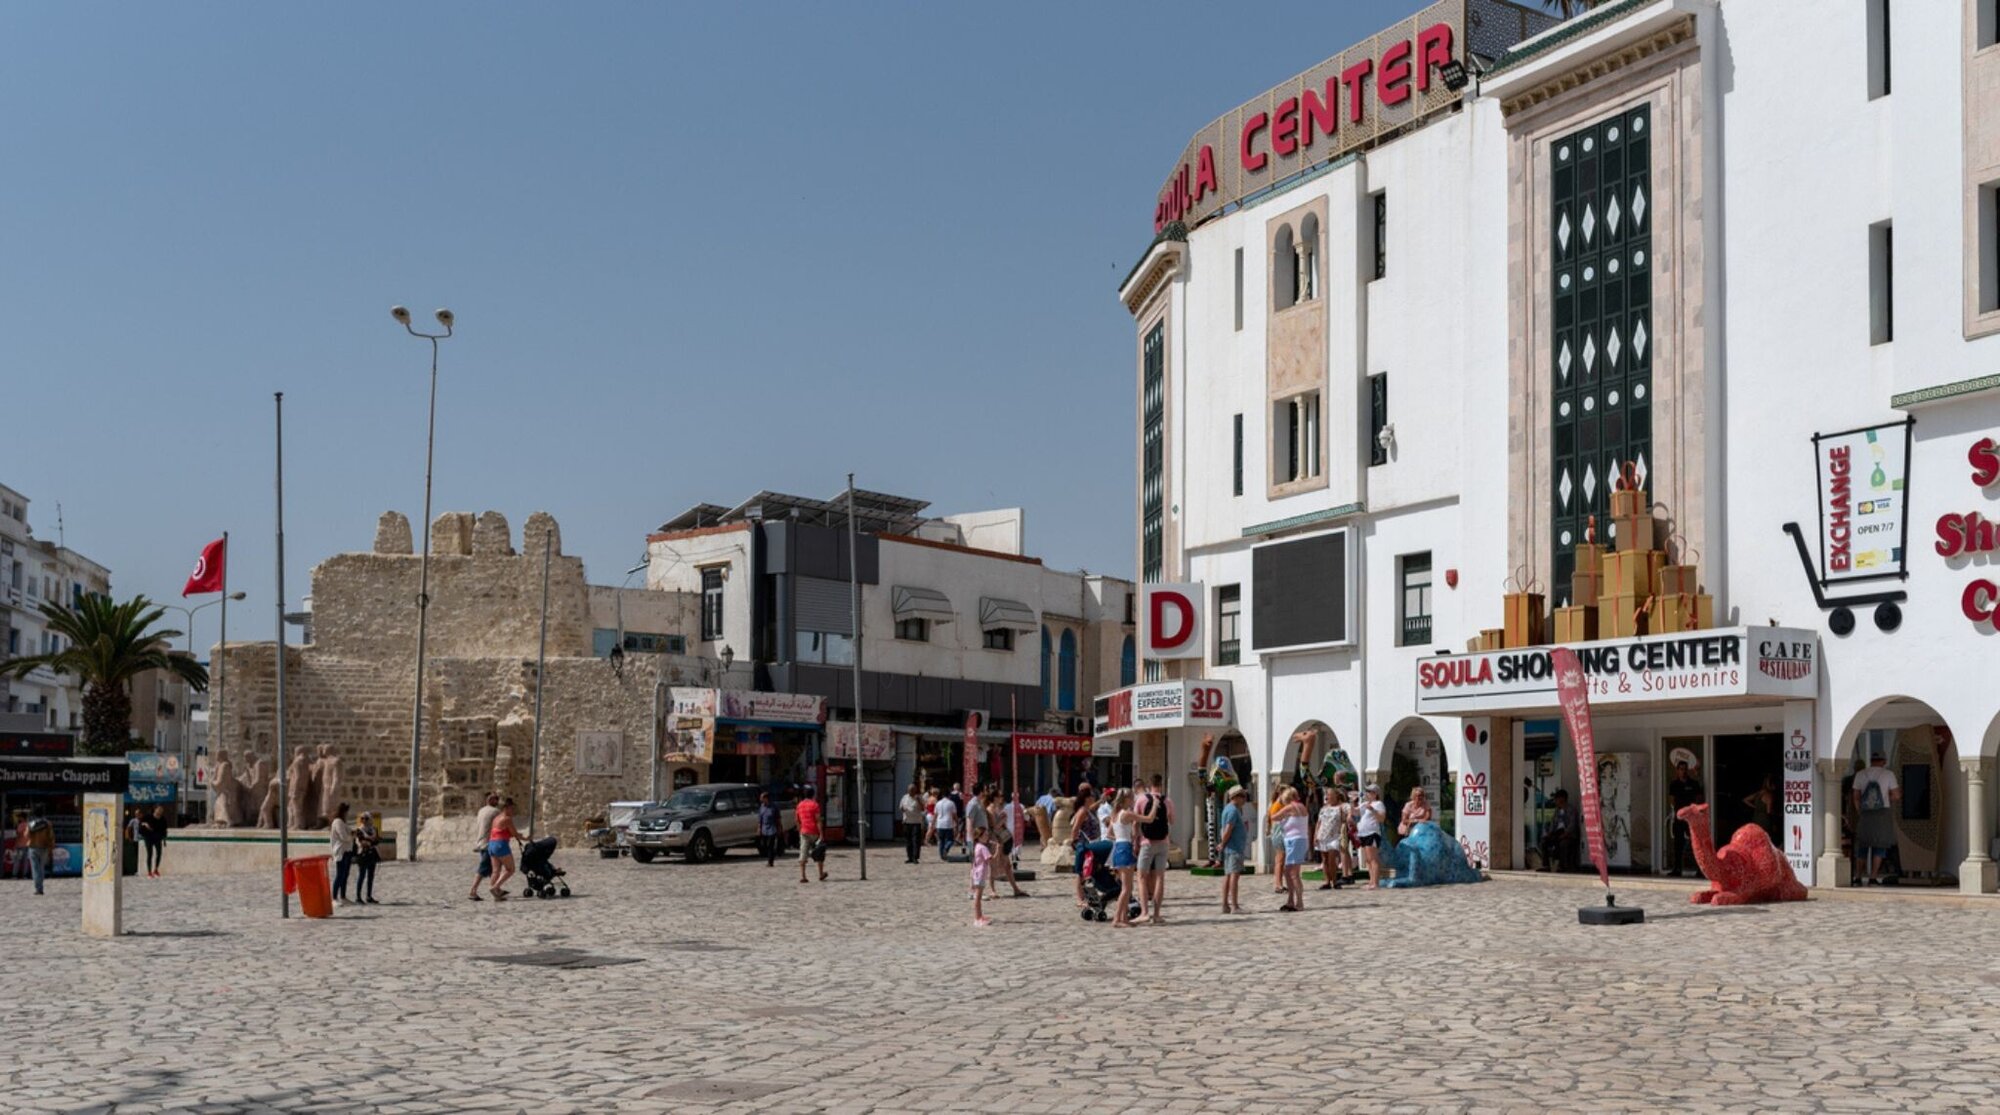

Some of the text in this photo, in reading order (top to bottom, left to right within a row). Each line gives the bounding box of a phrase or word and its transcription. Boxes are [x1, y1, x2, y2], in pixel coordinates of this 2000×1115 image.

[1241, 23, 1454, 171] CENTER
[1830, 445, 1850, 572] EXCHANGE
[1858, 524, 1880, 535] OPEN
[1935, 511, 2000, 558] Sh
[1151, 591, 1194, 649] D
[1759, 641, 1812, 658] CAFE
[1420, 657, 1494, 688] SOULA
[1628, 635, 1740, 670] CENTER
[1759, 658, 1812, 680] RESTAURANT
[1618, 671, 1632, 693] &
[1642, 667, 1739, 692] Souvenirs
[1137, 696, 1182, 708] EXPERIENCE
[1190, 688, 1223, 711] 3D
[1019, 739, 1054, 750] SOUSSA
[1057, 740, 1080, 751] FOOD
[1785, 750, 1811, 760] CAFE
[62, 769, 110, 784] Chappati
[1785, 781, 1811, 790] ROOF
[1785, 791, 1811, 803] TOP
[1785, 804, 1811, 814] CAFE
